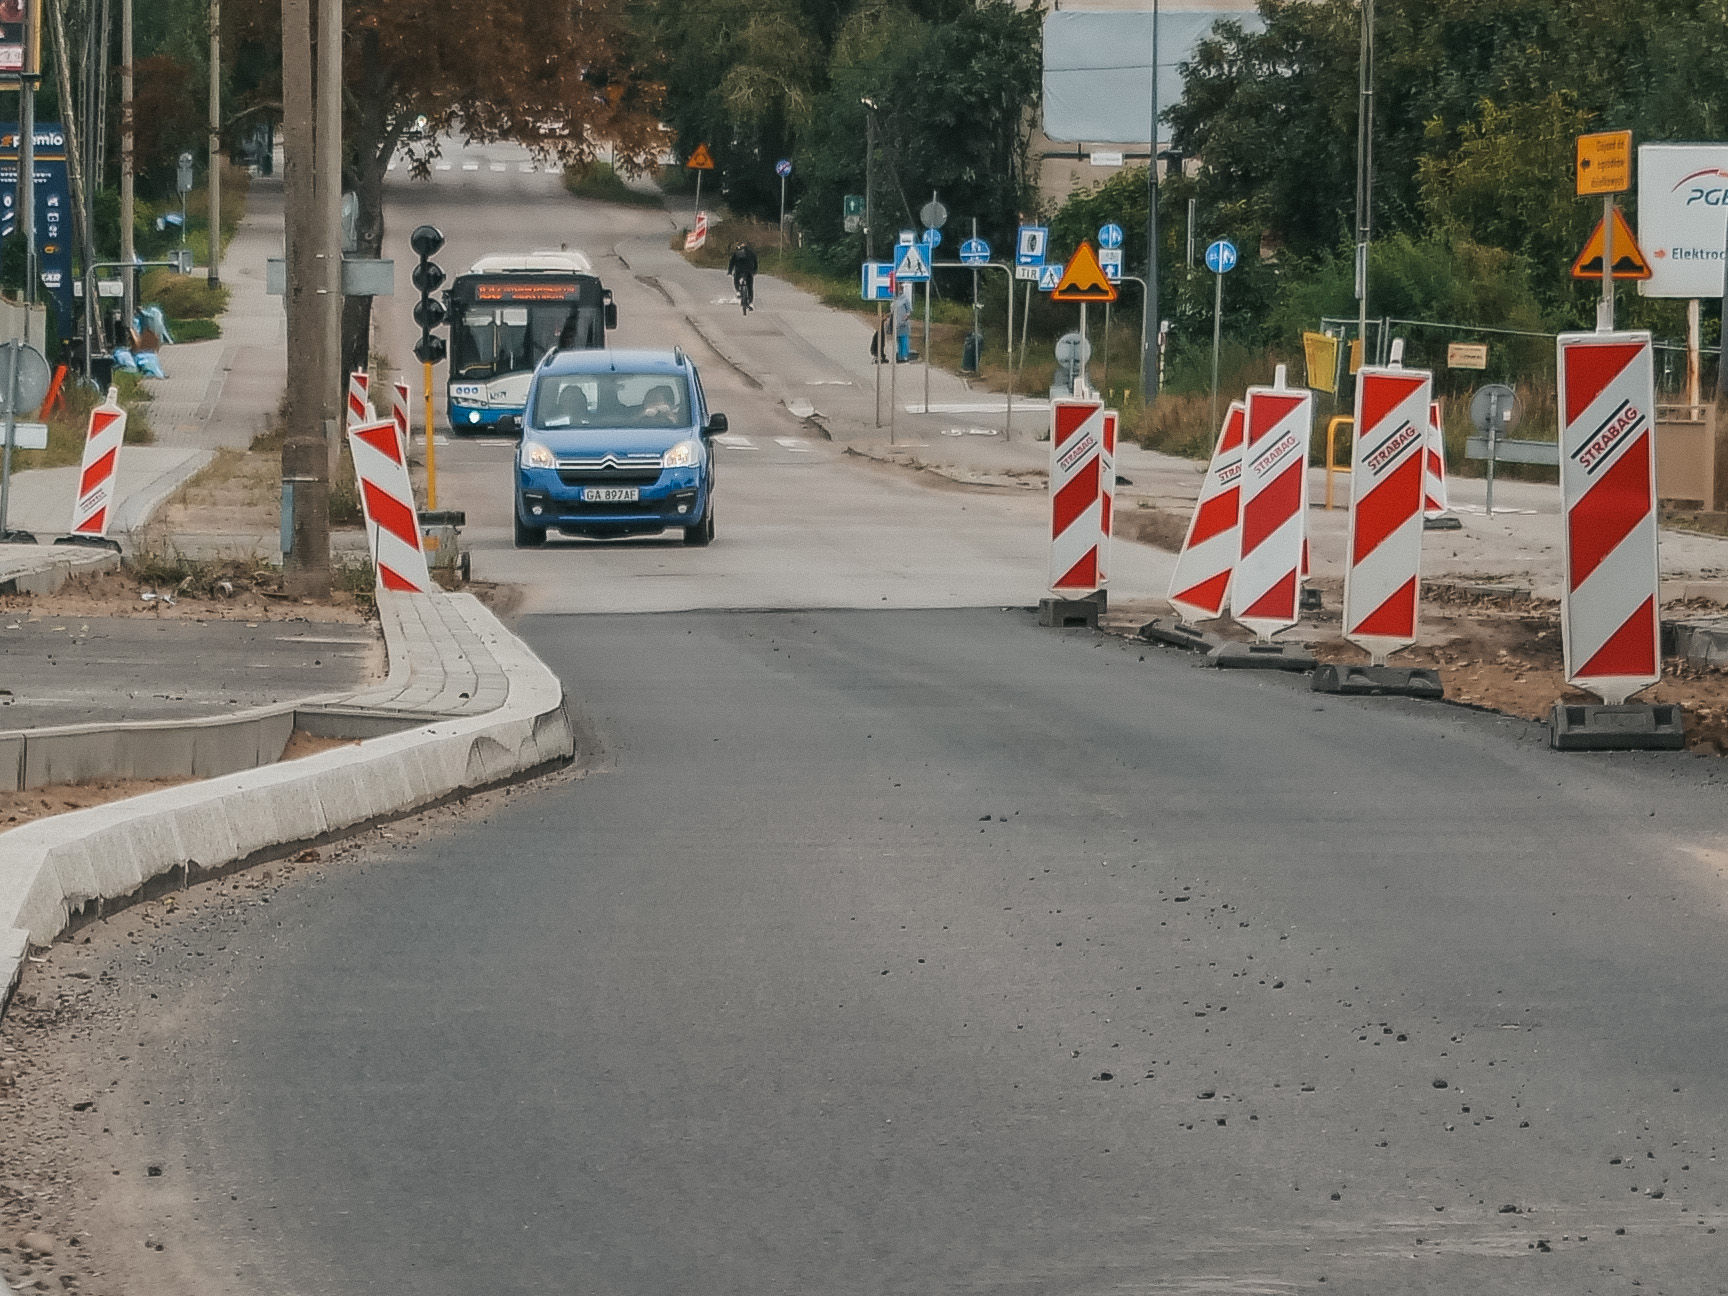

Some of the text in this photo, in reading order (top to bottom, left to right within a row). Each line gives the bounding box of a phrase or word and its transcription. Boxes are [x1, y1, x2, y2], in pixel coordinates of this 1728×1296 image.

[1021, 267, 1037, 279] TIR
[1253, 435, 1296, 473] STRABAG
[1368, 426, 1416, 471] STRABAG
[1579, 407, 1638, 468] STRABAG
[586, 489, 637, 500] GA 897AF
